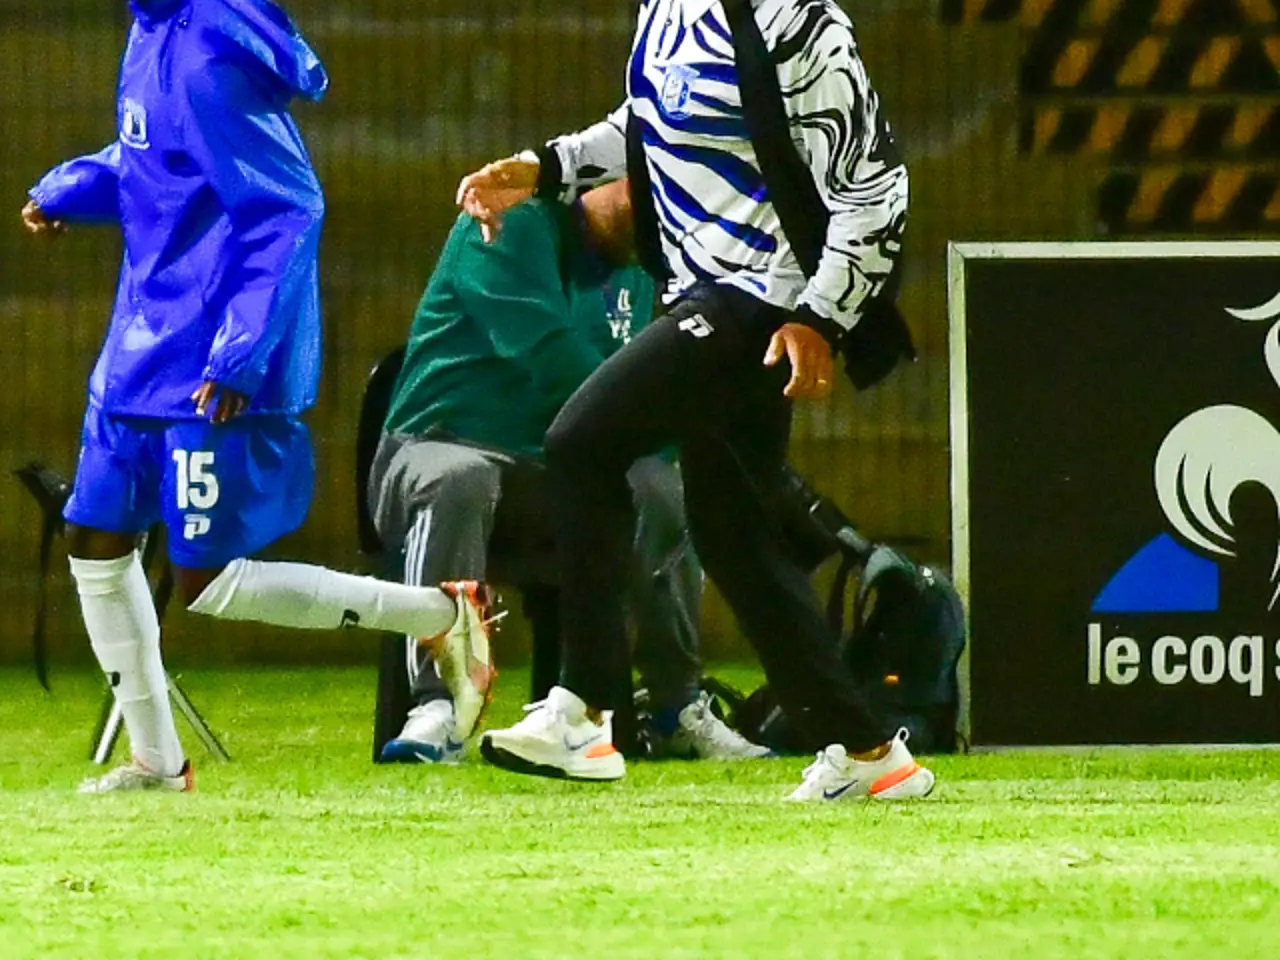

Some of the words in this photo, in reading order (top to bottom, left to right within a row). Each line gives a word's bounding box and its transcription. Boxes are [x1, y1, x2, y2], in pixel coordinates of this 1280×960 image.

[172, 449, 219, 509] 15
[1087, 623, 1141, 685] le
[1151, 635, 1264, 697] coq
